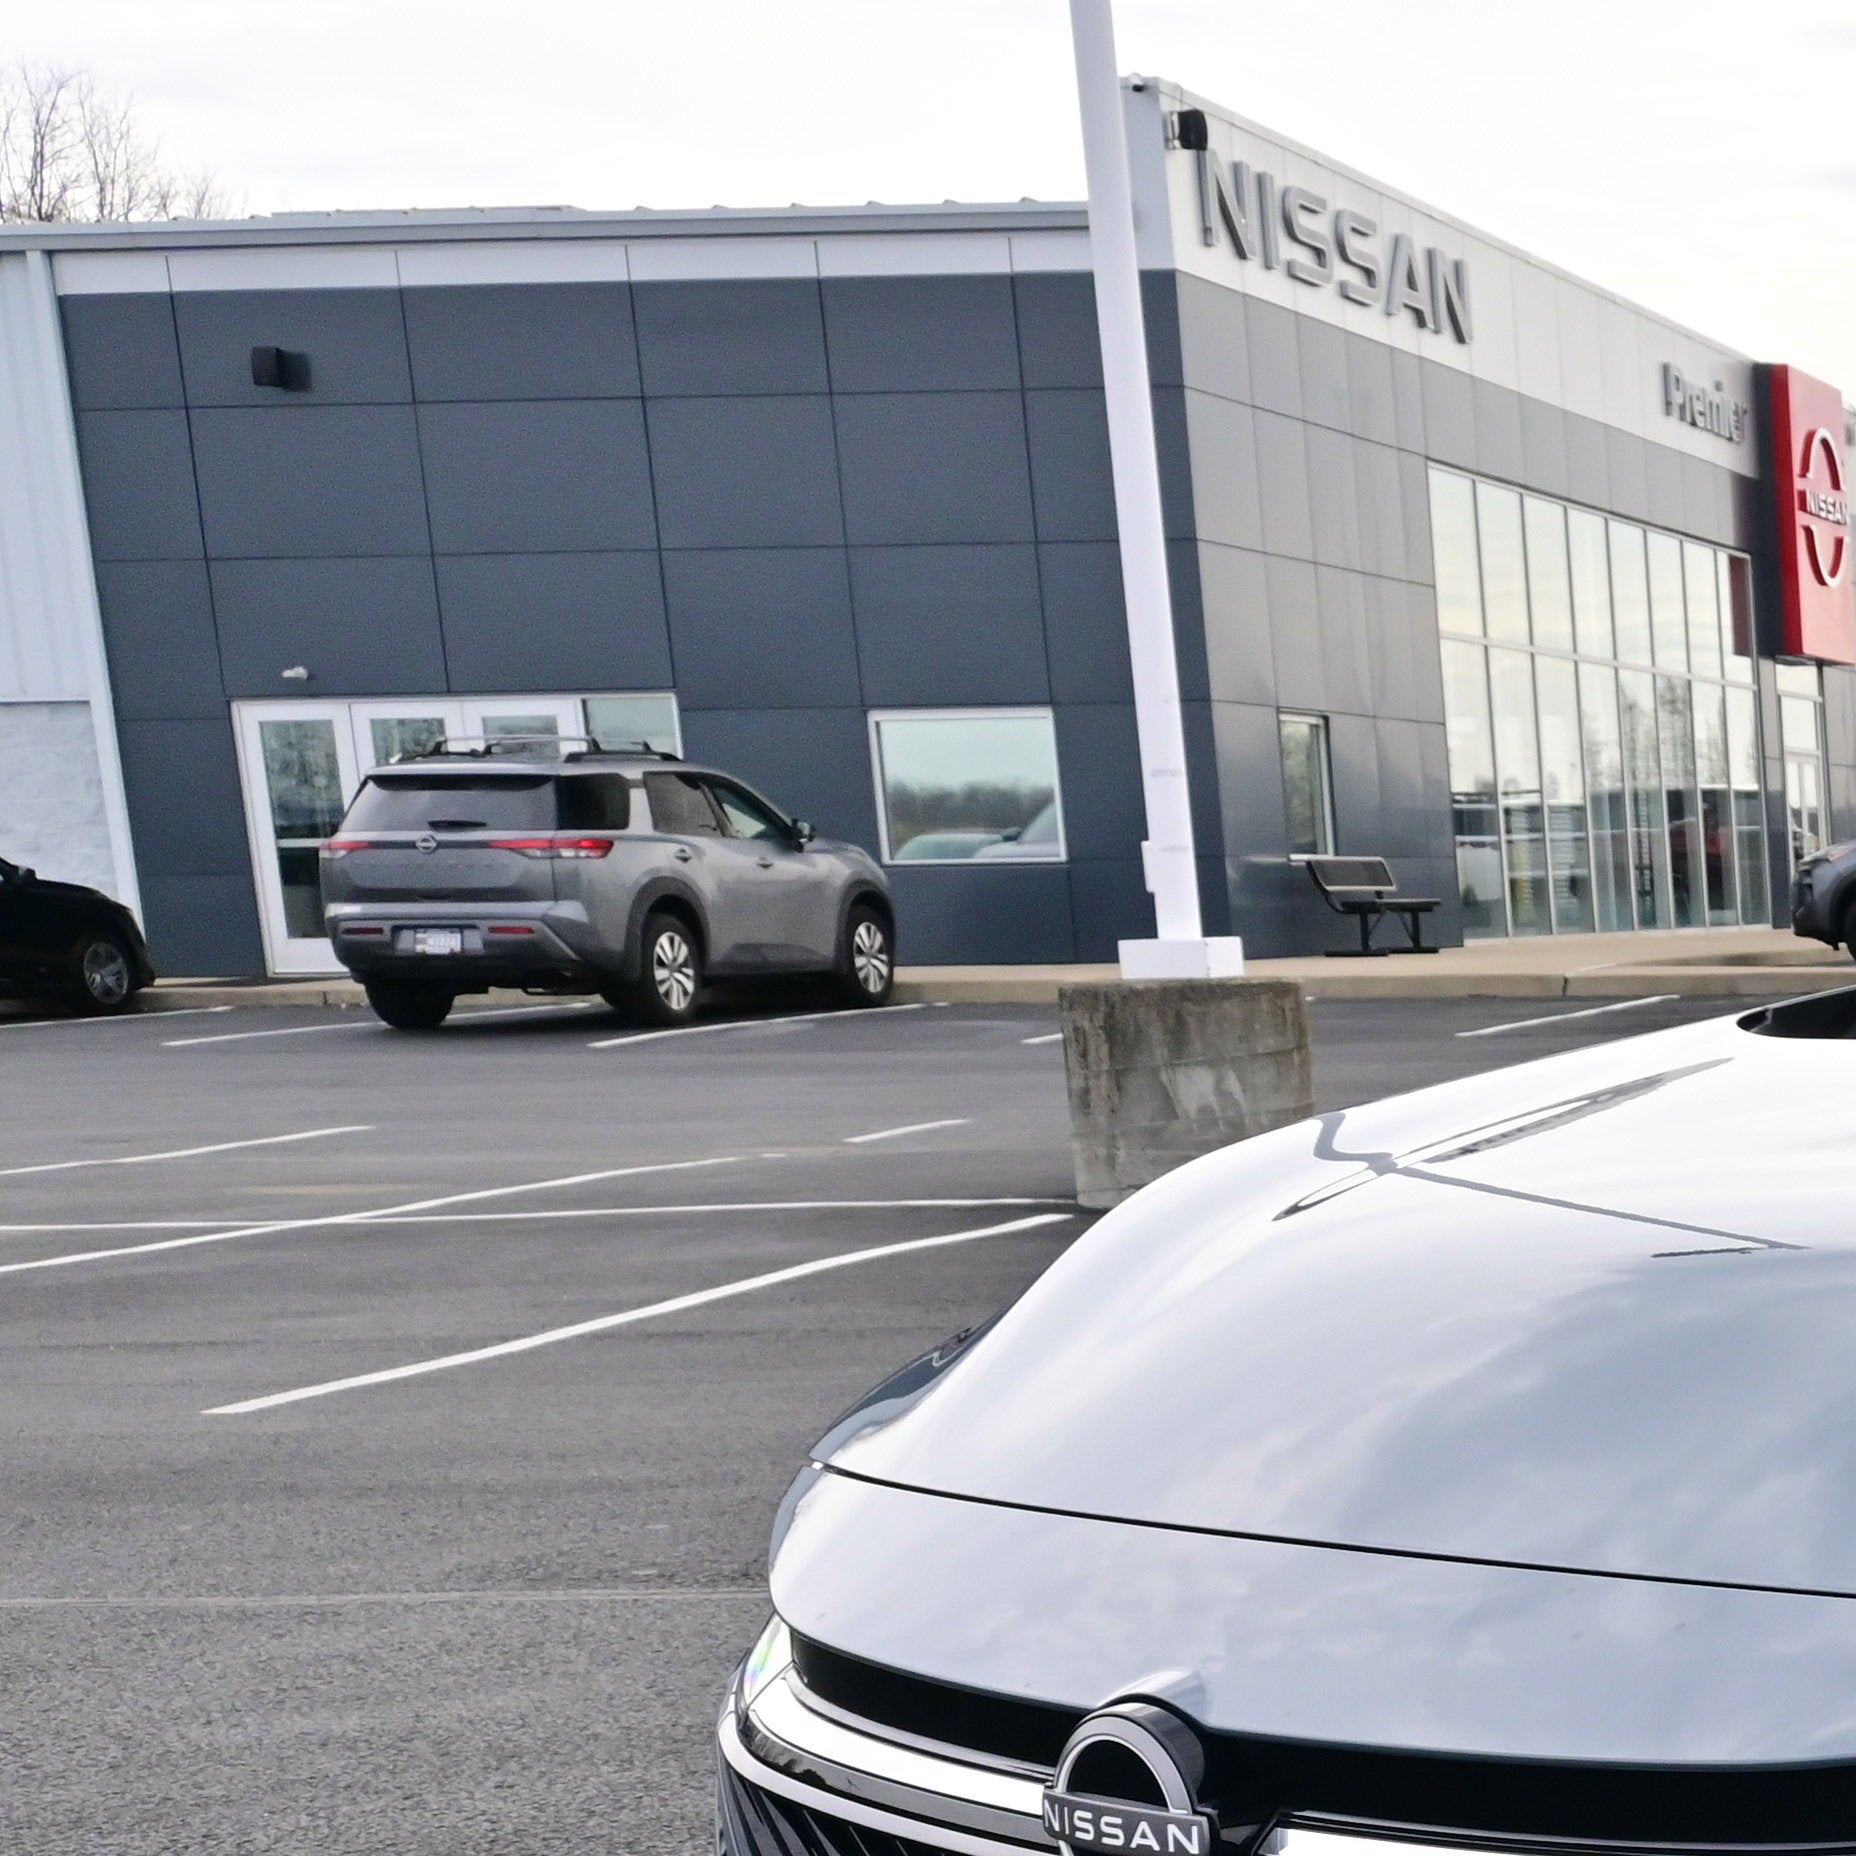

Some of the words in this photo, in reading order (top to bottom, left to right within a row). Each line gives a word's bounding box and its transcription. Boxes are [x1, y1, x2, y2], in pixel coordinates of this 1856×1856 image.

[1197, 149, 1474, 344] NISSAN
[1662, 361, 1748, 444] Premier
[1805, 489, 1848, 525] NISSAN
[1044, 1799, 1200, 1855] NISSAN
